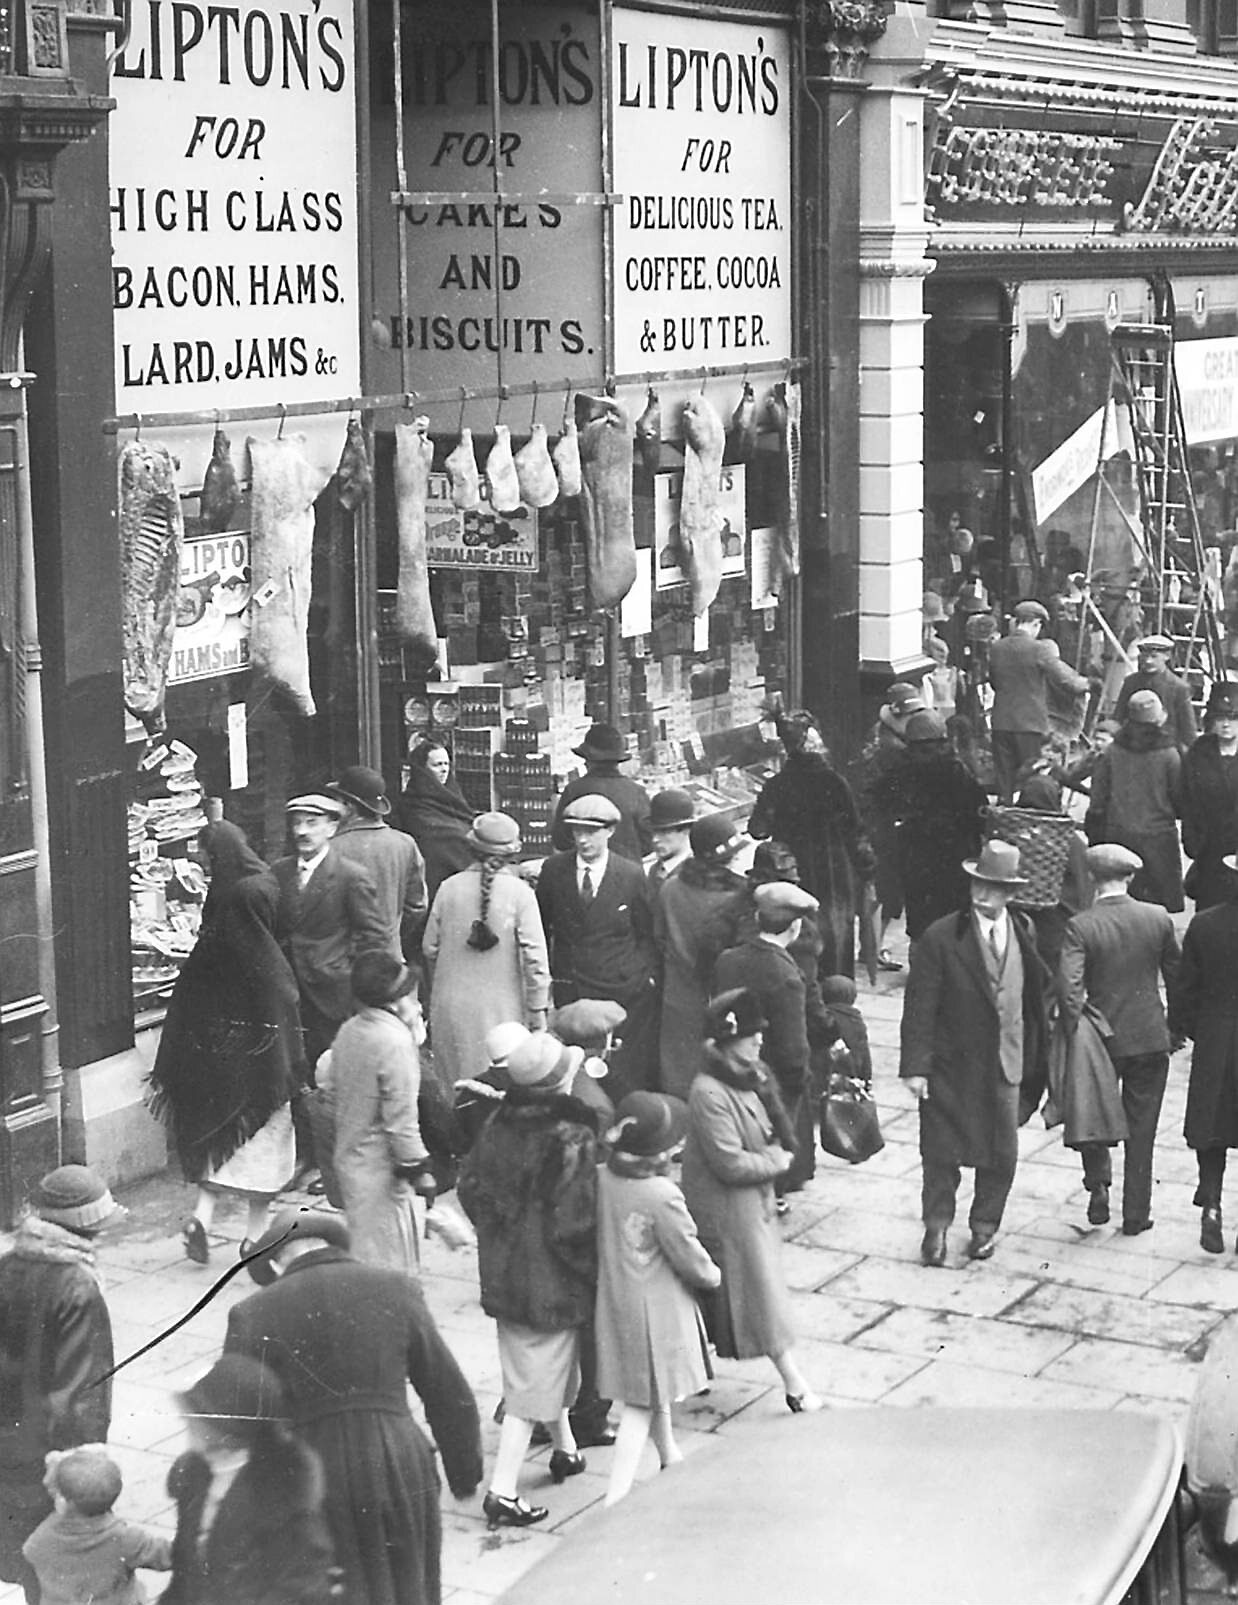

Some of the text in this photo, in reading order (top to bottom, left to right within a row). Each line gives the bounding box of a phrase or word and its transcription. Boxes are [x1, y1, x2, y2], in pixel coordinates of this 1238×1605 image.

[113, 0, 345, 92] LIPTON'S
[618, 36, 779, 116] LIPTON'S
[185, 116, 266, 160] FOR
[430, 132, 521, 167] FOR
[681, 138, 732, 173] FOR
[110, 187, 343, 232] HIGH CLASS
[629, 195, 734, 230] DELICIOUS
[439, 255, 521, 290] AND
[716, 256, 781, 289] COCOA
[640, 319, 657, 353] &
[225, 337, 308, 380] JAMS
[174, 642, 222, 676] HAMS
